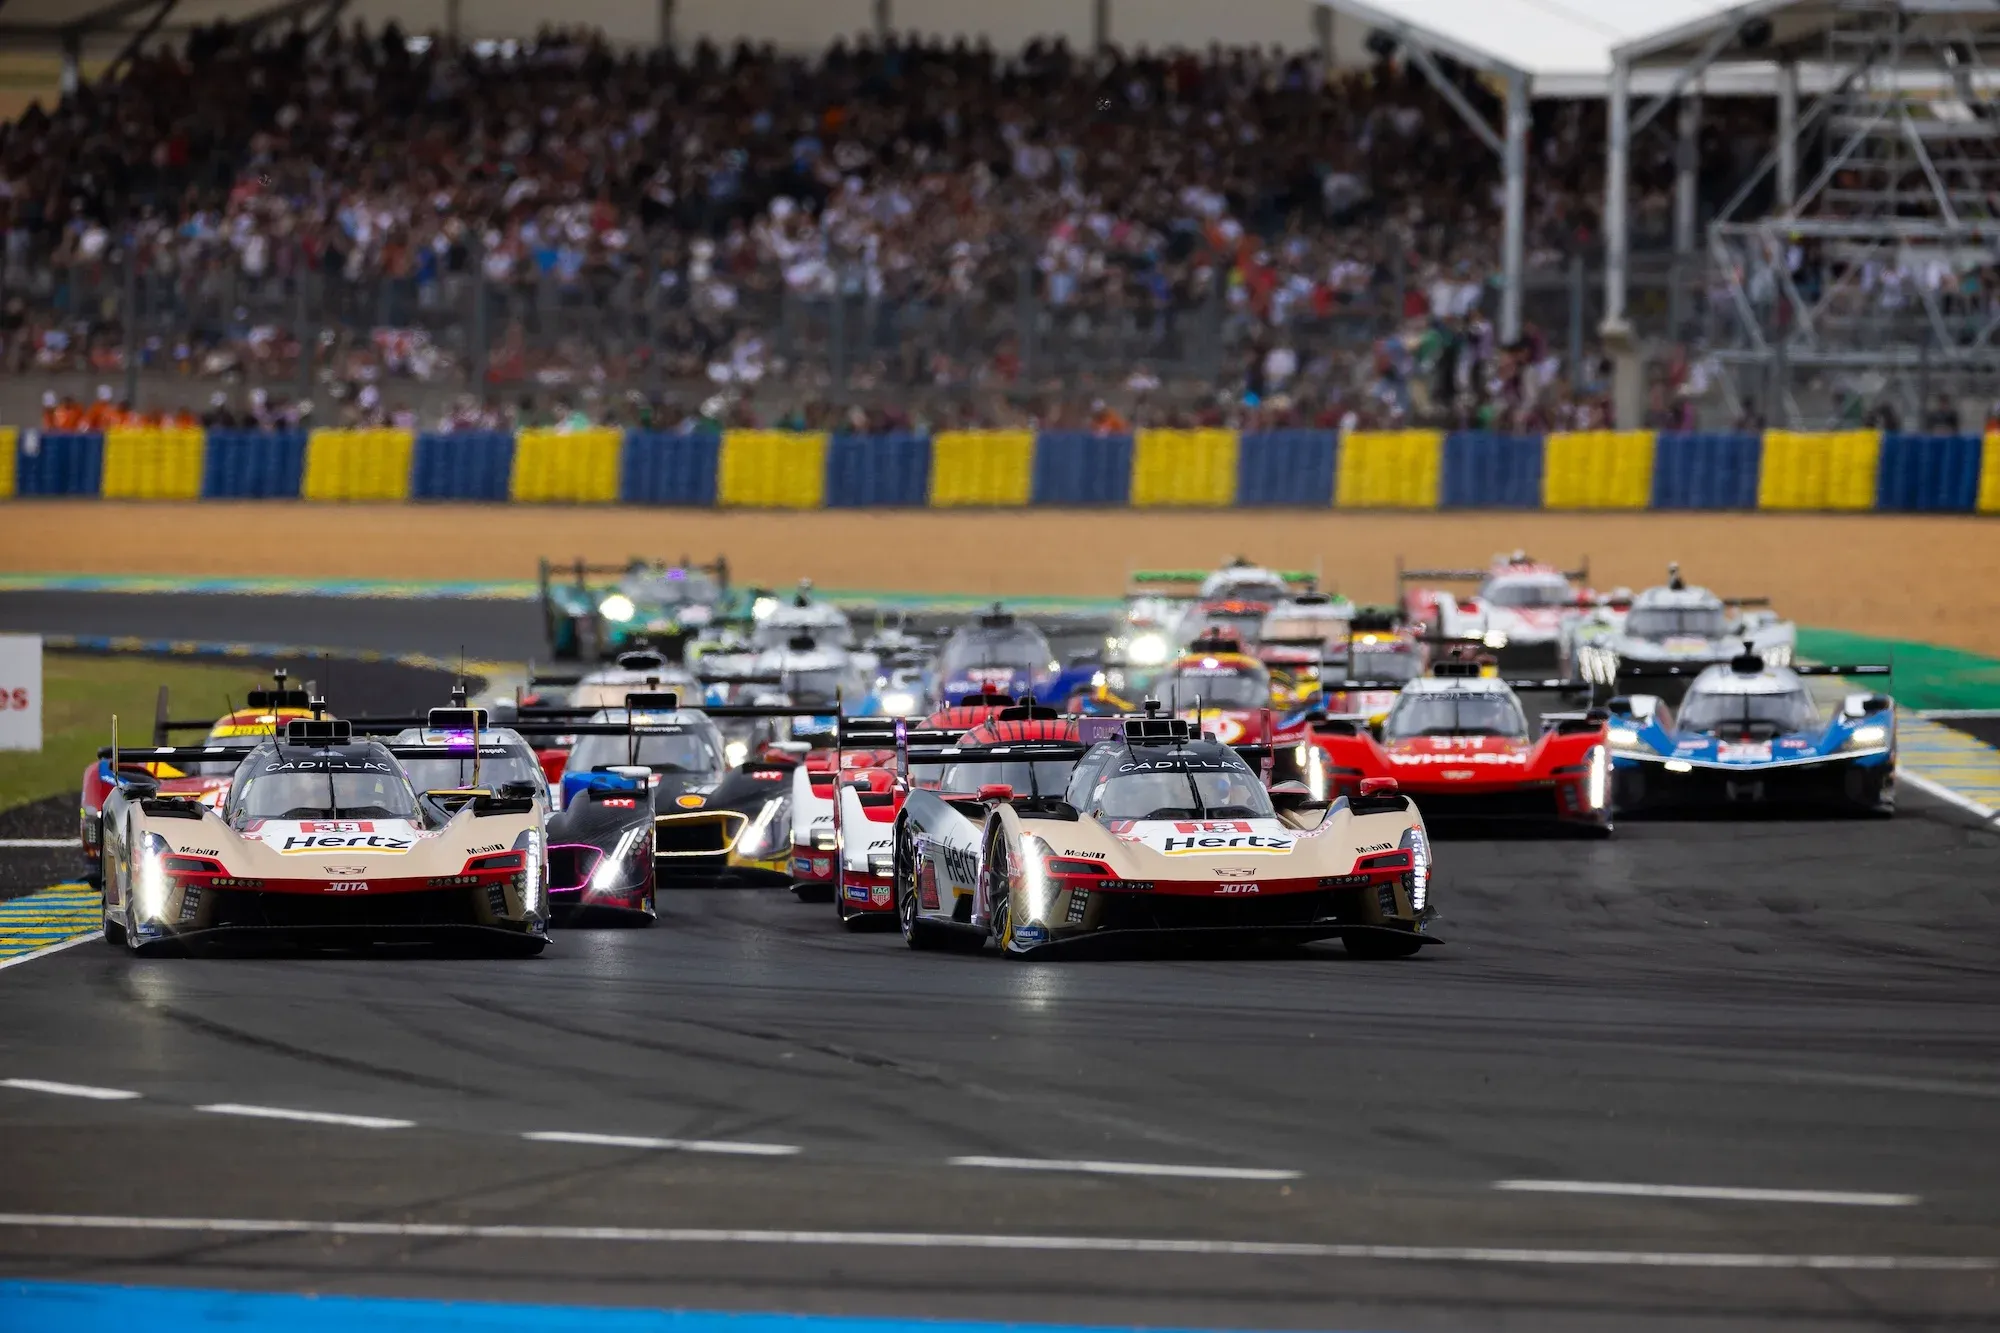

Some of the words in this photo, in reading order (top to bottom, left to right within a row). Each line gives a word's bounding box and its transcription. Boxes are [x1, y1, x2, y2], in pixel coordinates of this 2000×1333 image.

[1388, 753, 1527, 764] WHELEN
[265, 761, 391, 772] CADILLAC
[1119, 761, 1245, 773] CADILLAC
[283, 836, 412, 850] Hertz
[1165, 836, 1292, 850] Hertz
[180, 846, 209, 855] Mobil
[466, 845, 495, 855] Mobil
[1064, 849, 1095, 858] Mobil
[1356, 844, 1384, 854] Mobil
[324, 882, 368, 891] JOTA
[1214, 884, 1259, 893] JOTA
